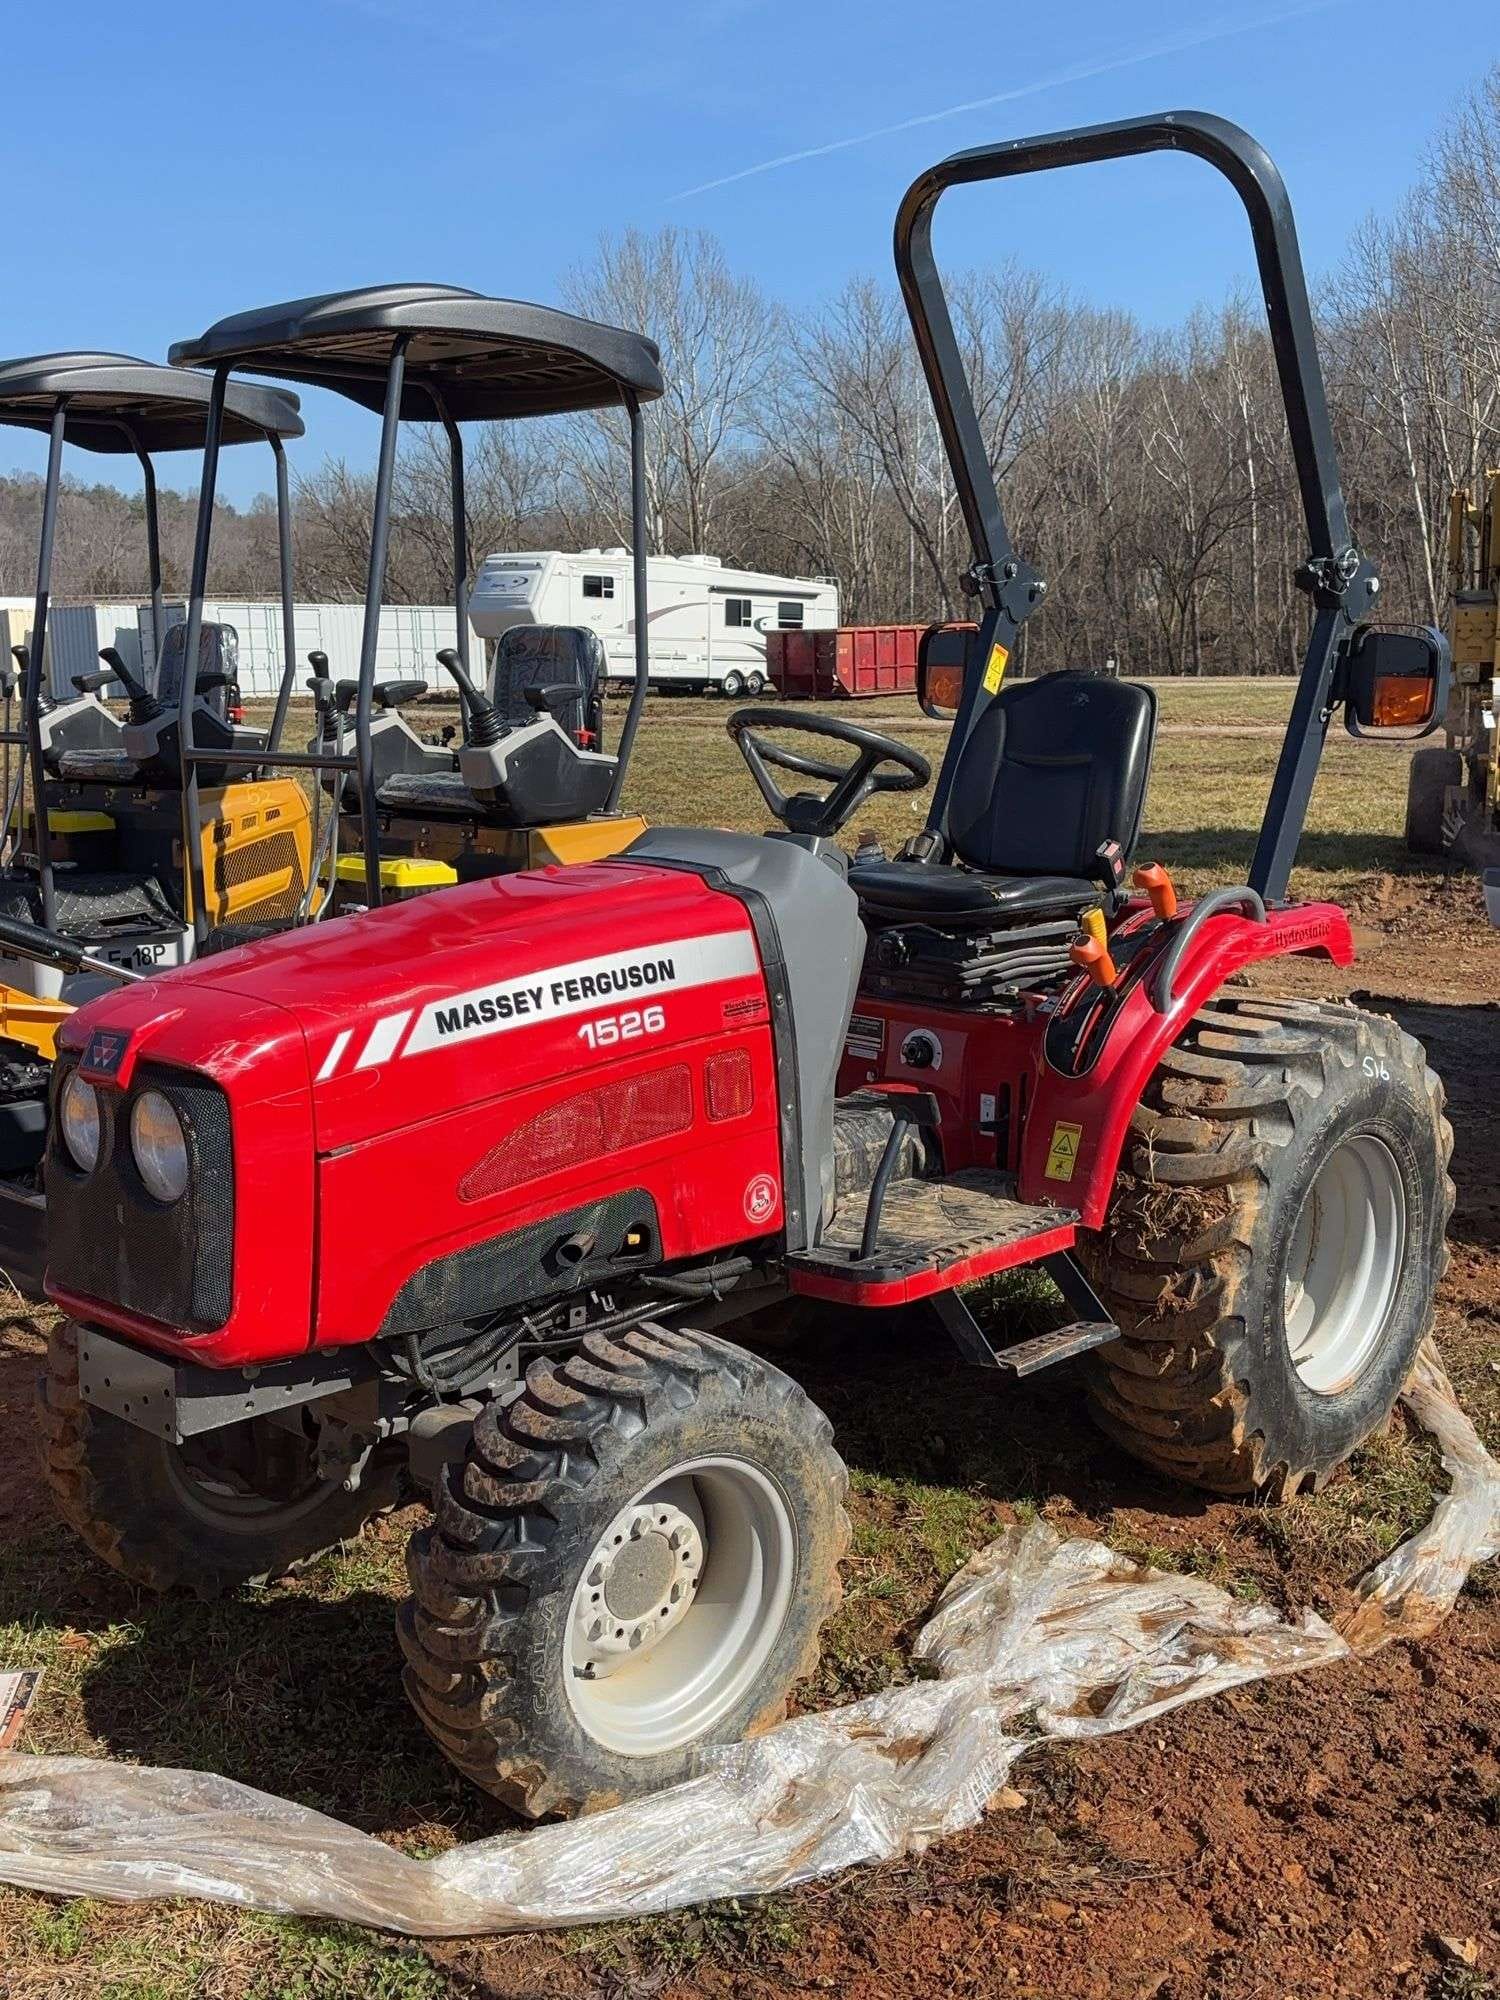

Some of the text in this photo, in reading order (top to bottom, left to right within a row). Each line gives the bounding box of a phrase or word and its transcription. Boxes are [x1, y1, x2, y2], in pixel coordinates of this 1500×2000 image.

[1275, 921, 1331, 949] Hydrostatic
[433, 958, 676, 1035] MASSEY FERGUSON
[577, 1004, 667, 1050] 1526
